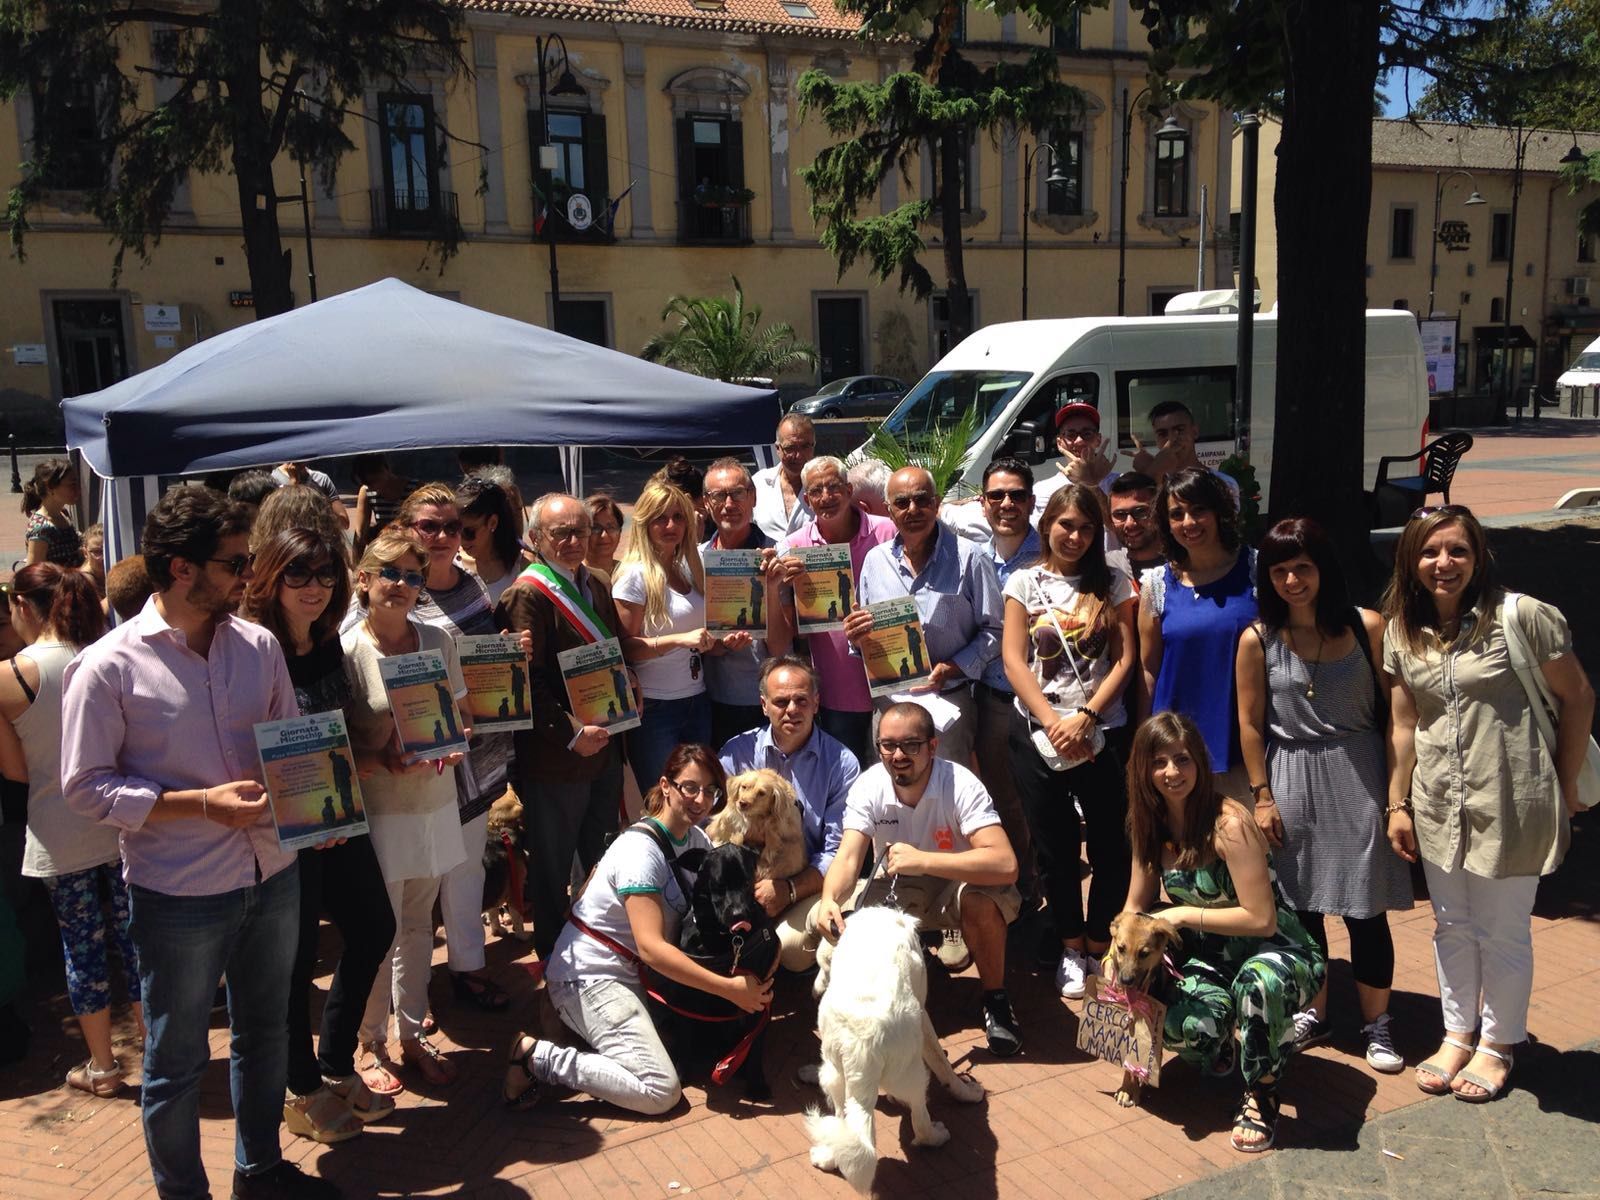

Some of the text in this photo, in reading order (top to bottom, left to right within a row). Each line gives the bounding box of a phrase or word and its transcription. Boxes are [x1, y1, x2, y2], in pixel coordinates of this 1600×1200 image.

[1197, 450, 1226, 458] CAMPANIA
[280, 726, 320, 737] Giornata
[280, 732, 323, 744] Microchip
[1087, 1001, 1132, 1030] CERCO
[1080, 1019, 1139, 1061] MAMMA
[1080, 1033, 1123, 1067] UMANA
